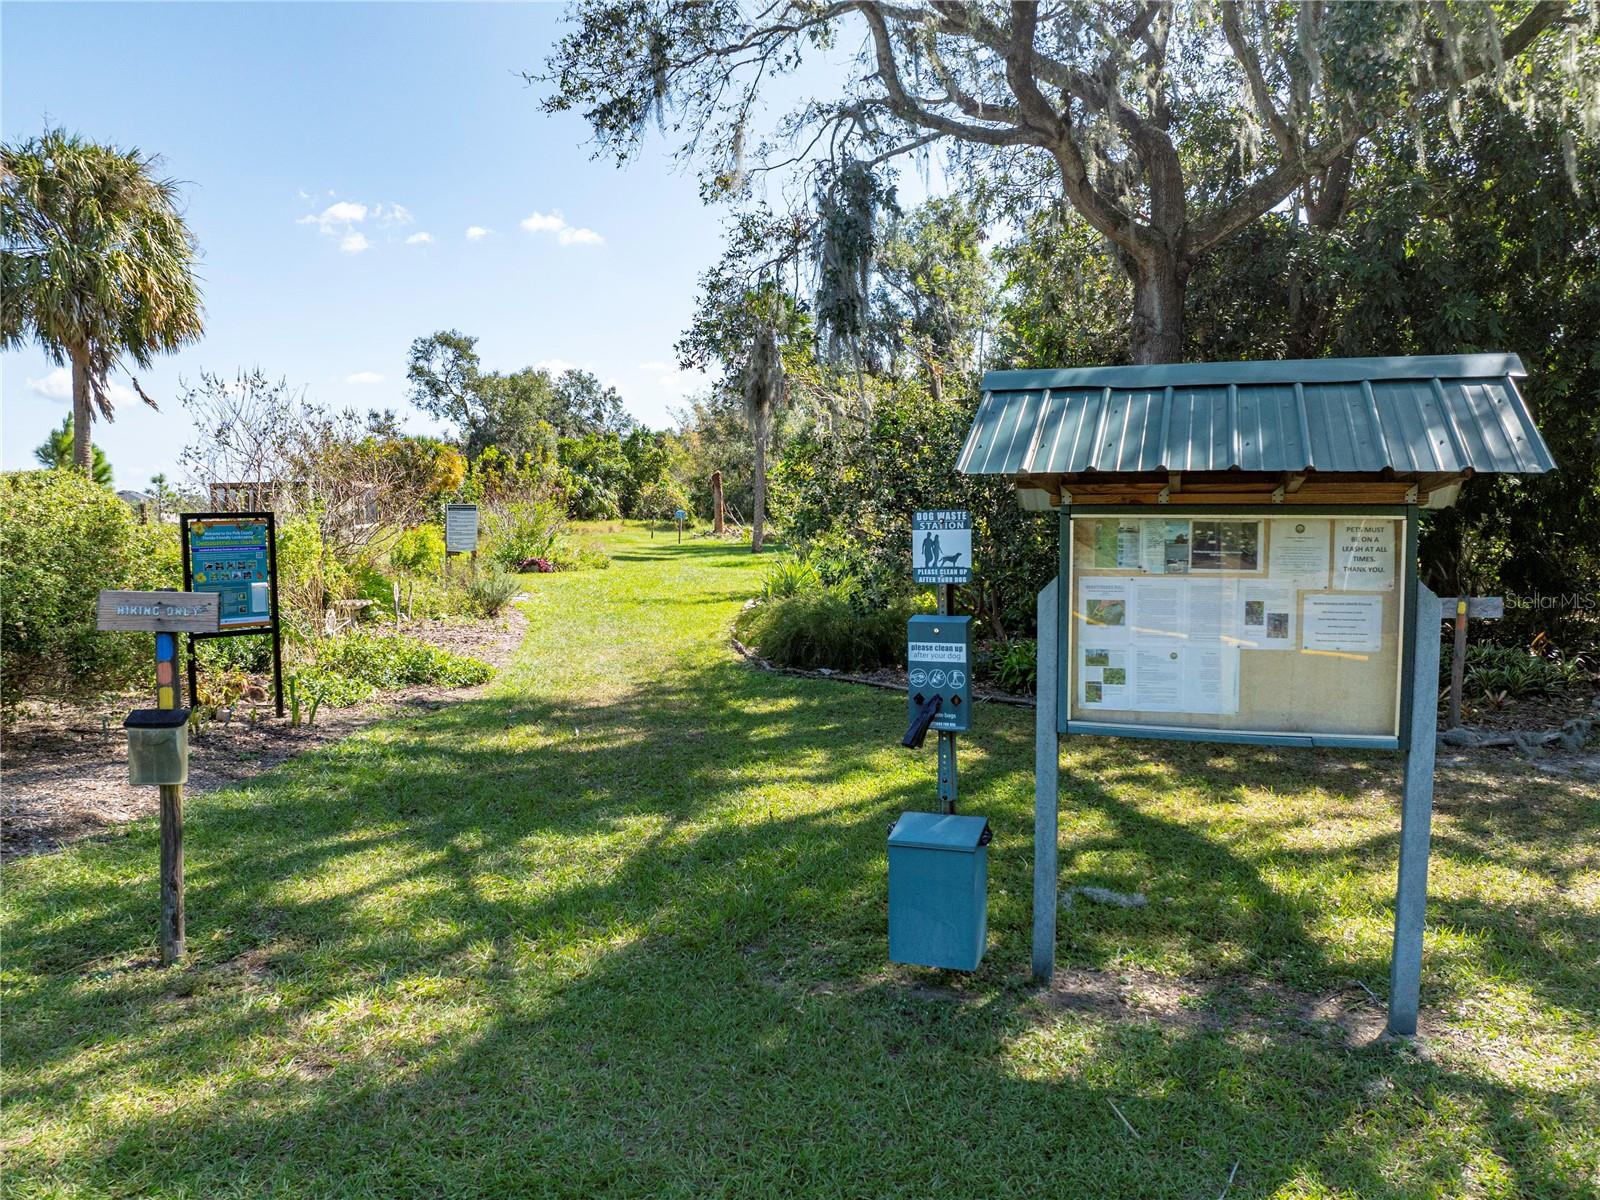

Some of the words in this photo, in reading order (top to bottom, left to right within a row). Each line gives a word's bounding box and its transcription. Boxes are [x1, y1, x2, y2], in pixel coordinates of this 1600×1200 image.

[916, 512, 934, 520] DOG
[937, 512, 967, 520] WASTE
[116, 606, 160, 616] HIKING
[166, 606, 200, 616] ONLY
